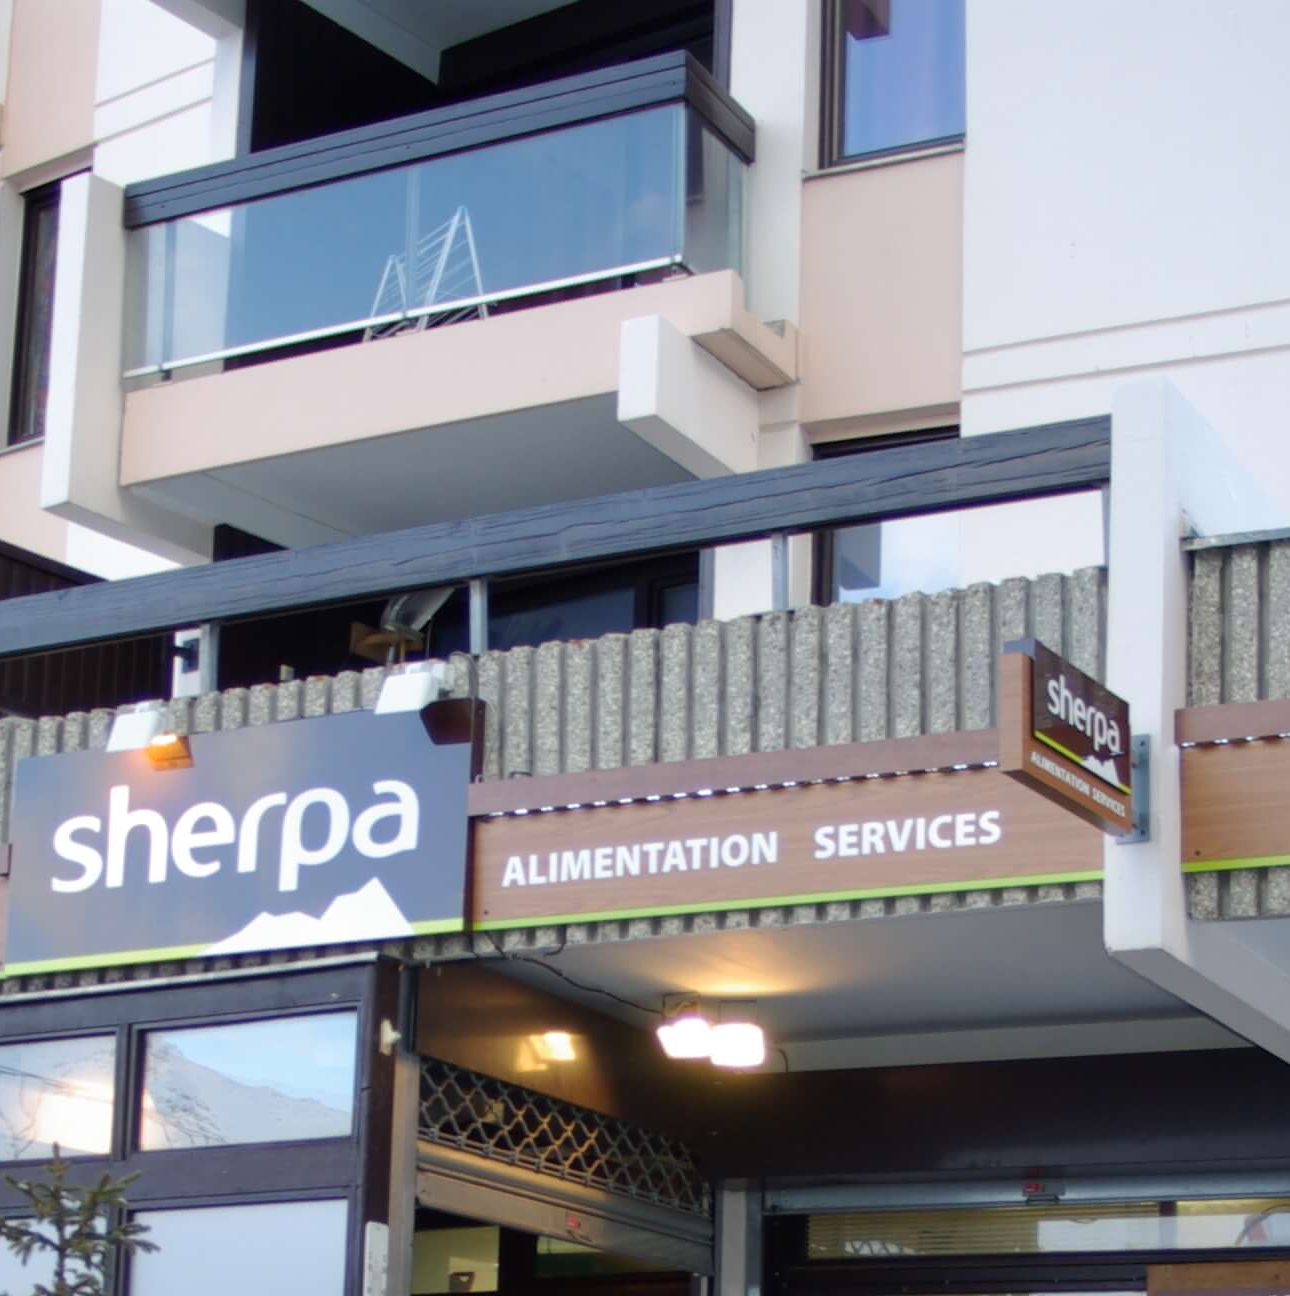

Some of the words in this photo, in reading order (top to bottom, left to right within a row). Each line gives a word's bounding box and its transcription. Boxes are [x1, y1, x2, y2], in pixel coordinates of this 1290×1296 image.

[1047, 674, 1121, 752] sherpa
[1030, 751, 1090, 798] ALIMENTATION
[1092, 786, 1126, 817] SERVICES
[50, 779, 420, 893] sherpa
[500, 831, 778, 888] ALIMENTATION
[812, 810, 1002, 860] SERVICES
